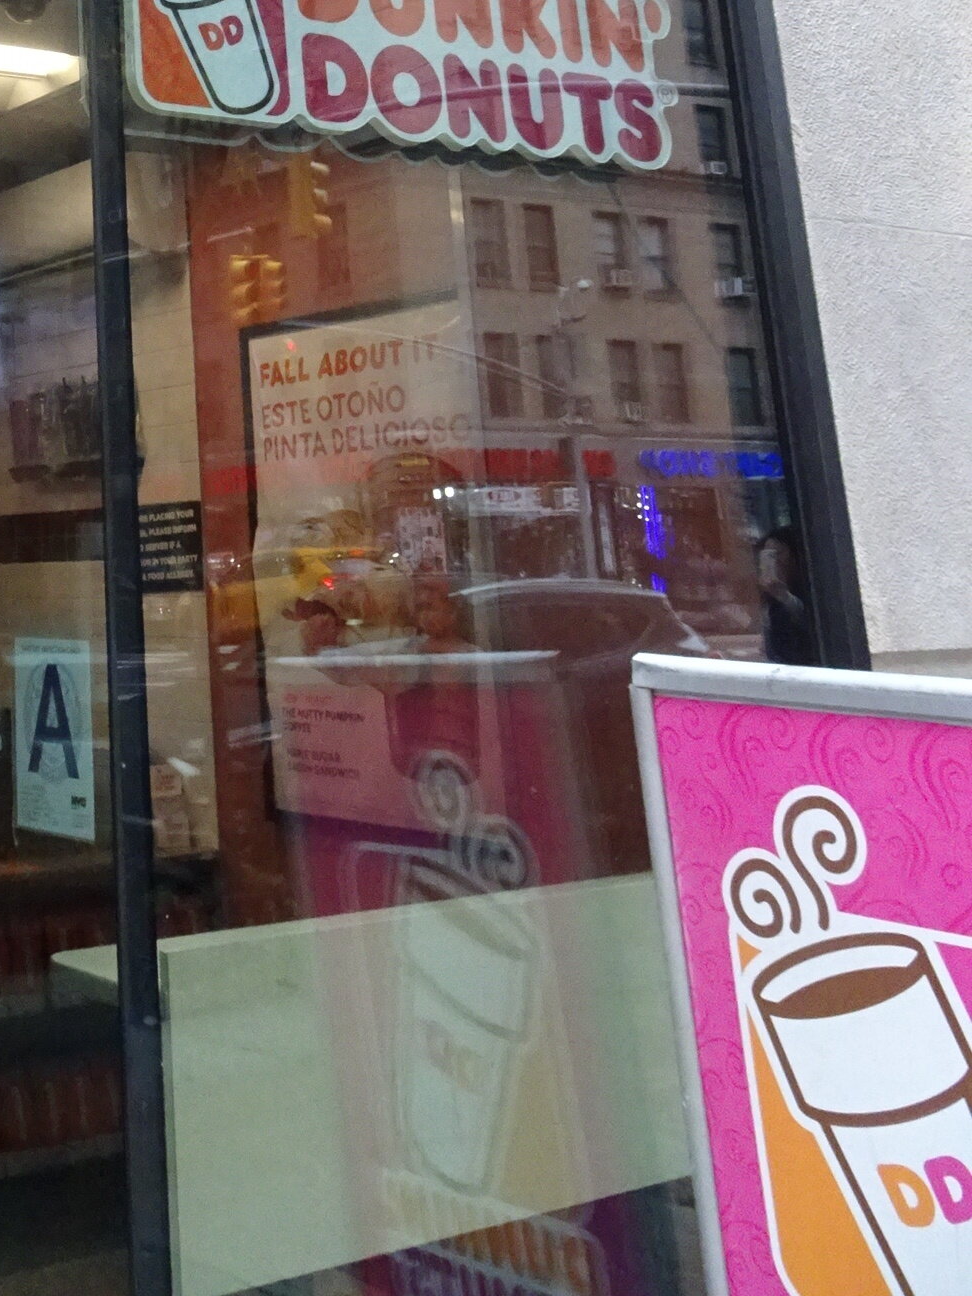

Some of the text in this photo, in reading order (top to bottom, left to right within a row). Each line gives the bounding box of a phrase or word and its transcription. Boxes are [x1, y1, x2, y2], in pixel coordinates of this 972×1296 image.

[198, 15, 244, 51] DD
[301, 32, 663, 163] DONUTS
[259, 356, 310, 388] FALL
[317, 338, 404, 379] ABOUT
[261, 381, 406, 430] ESTE OTOÑO
[264, 413, 472, 462] PINTA DELICIOSO
[28, 663, 80, 779] A
